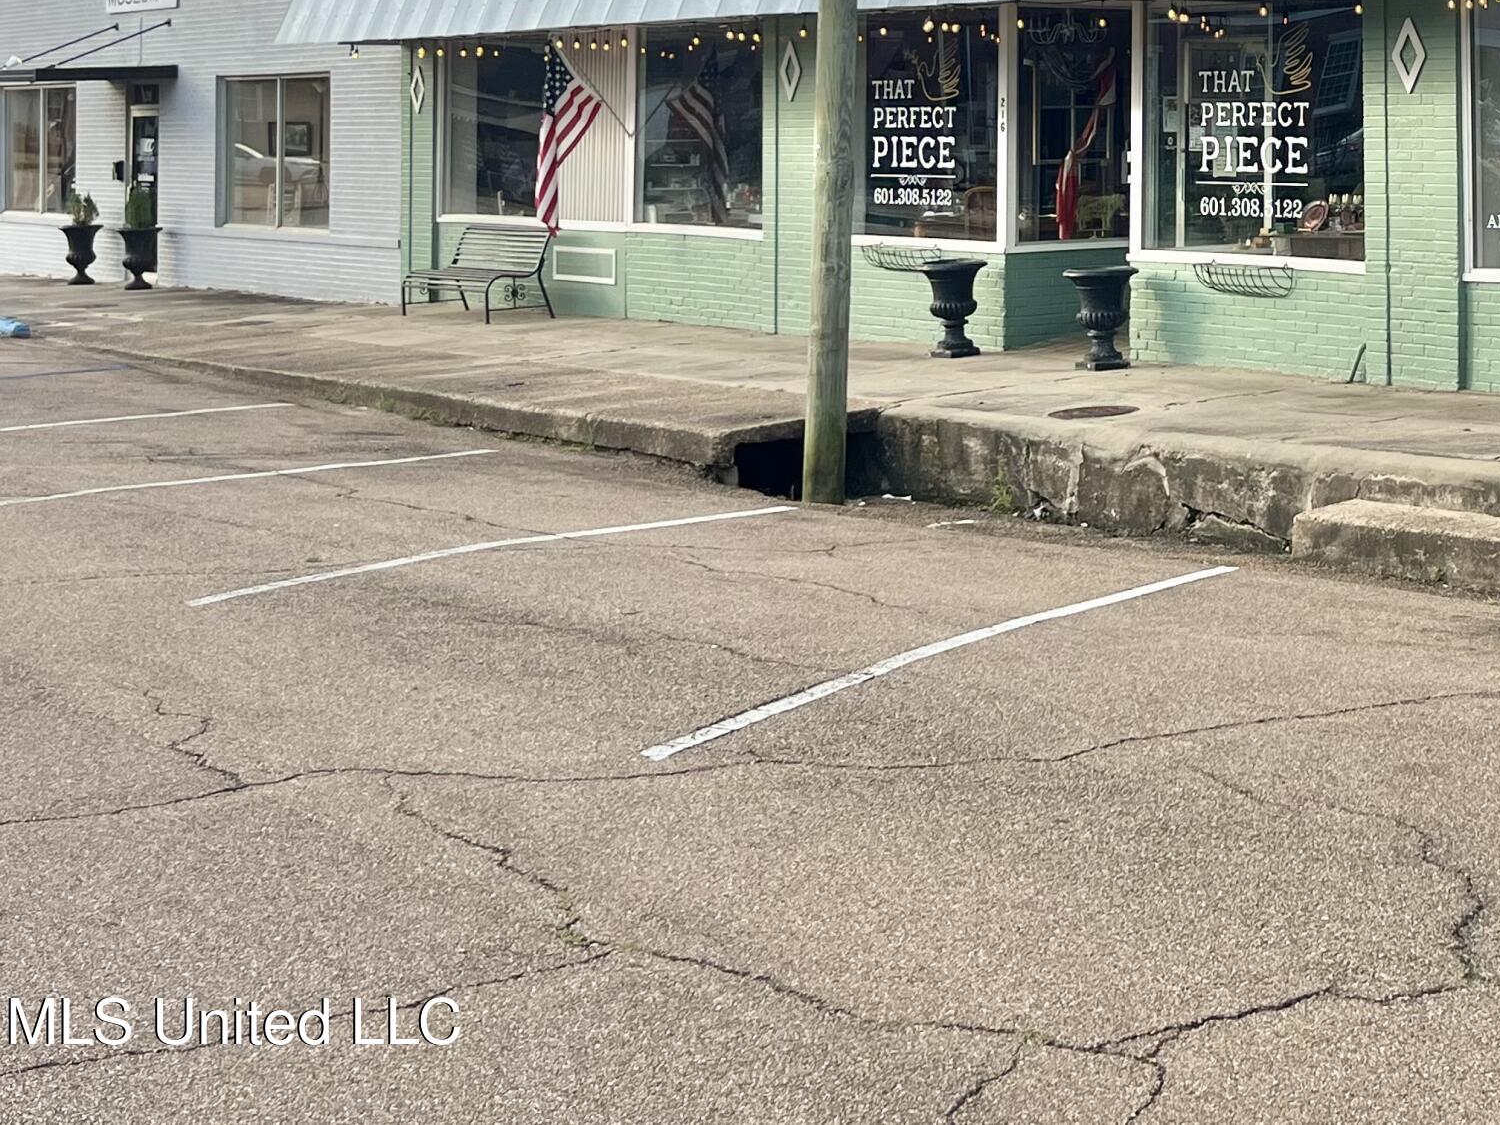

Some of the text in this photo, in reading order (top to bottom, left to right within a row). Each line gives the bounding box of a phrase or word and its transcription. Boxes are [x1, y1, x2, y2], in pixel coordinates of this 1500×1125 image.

[872, 79, 915, 100] THAT
[1199, 70, 1254, 93] THAT
[873, 106, 957, 129] PERFECT
[1200, 102, 1309, 127] PERFECT
[872, 136, 956, 169] PIECE
[1199, 136, 1308, 174] PIECE
[873, 188, 952, 205] 601.308.5122
[1200, 196, 1302, 219] 601.308.5122
